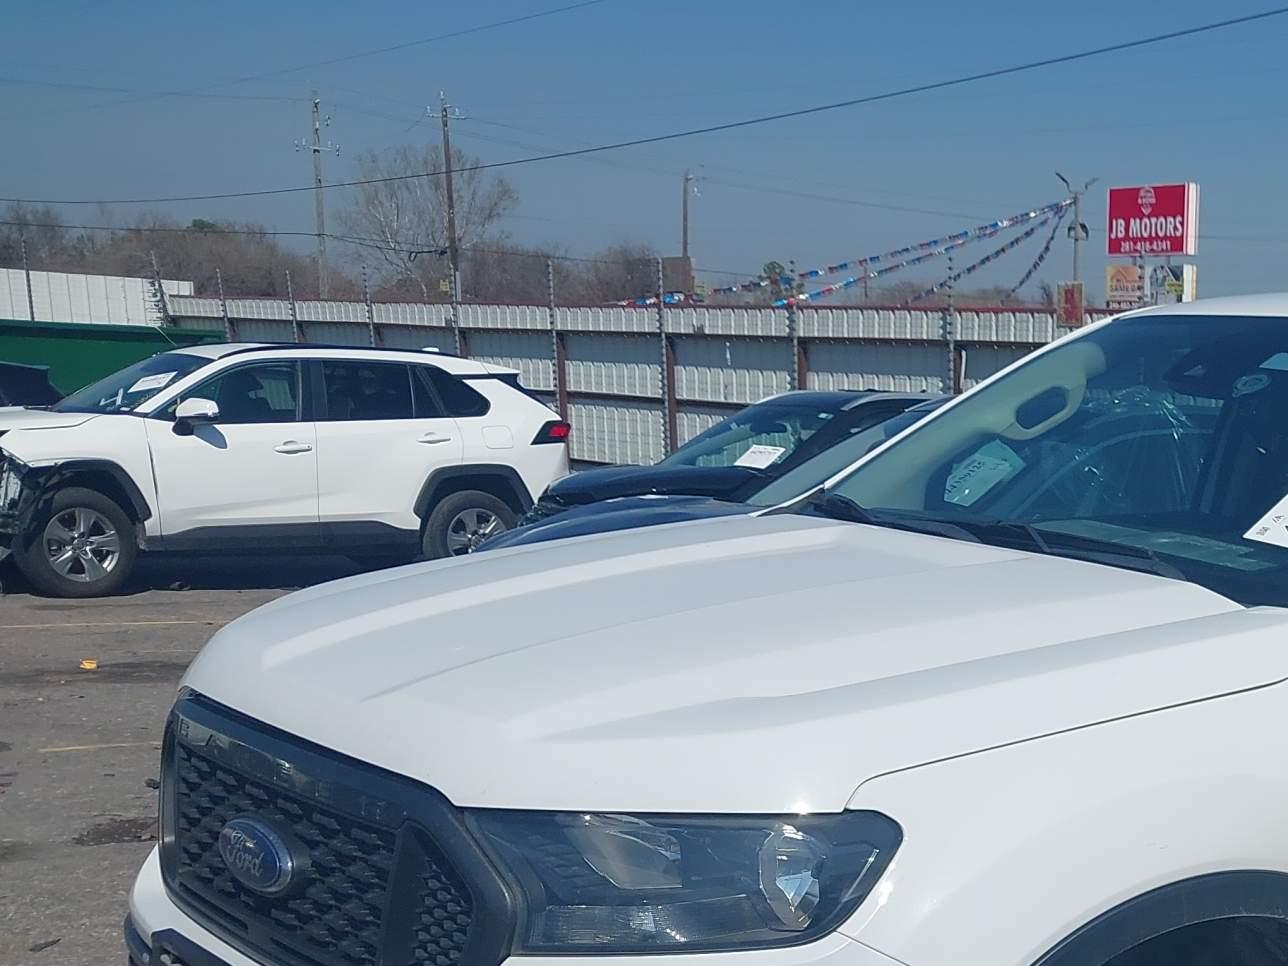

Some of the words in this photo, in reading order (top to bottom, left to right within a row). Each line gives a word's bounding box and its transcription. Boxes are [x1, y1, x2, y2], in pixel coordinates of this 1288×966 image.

[1110, 217, 1126, 239] JB
[1129, 214, 1183, 238] MOTORS
[225, 829, 266, 878] Ford
